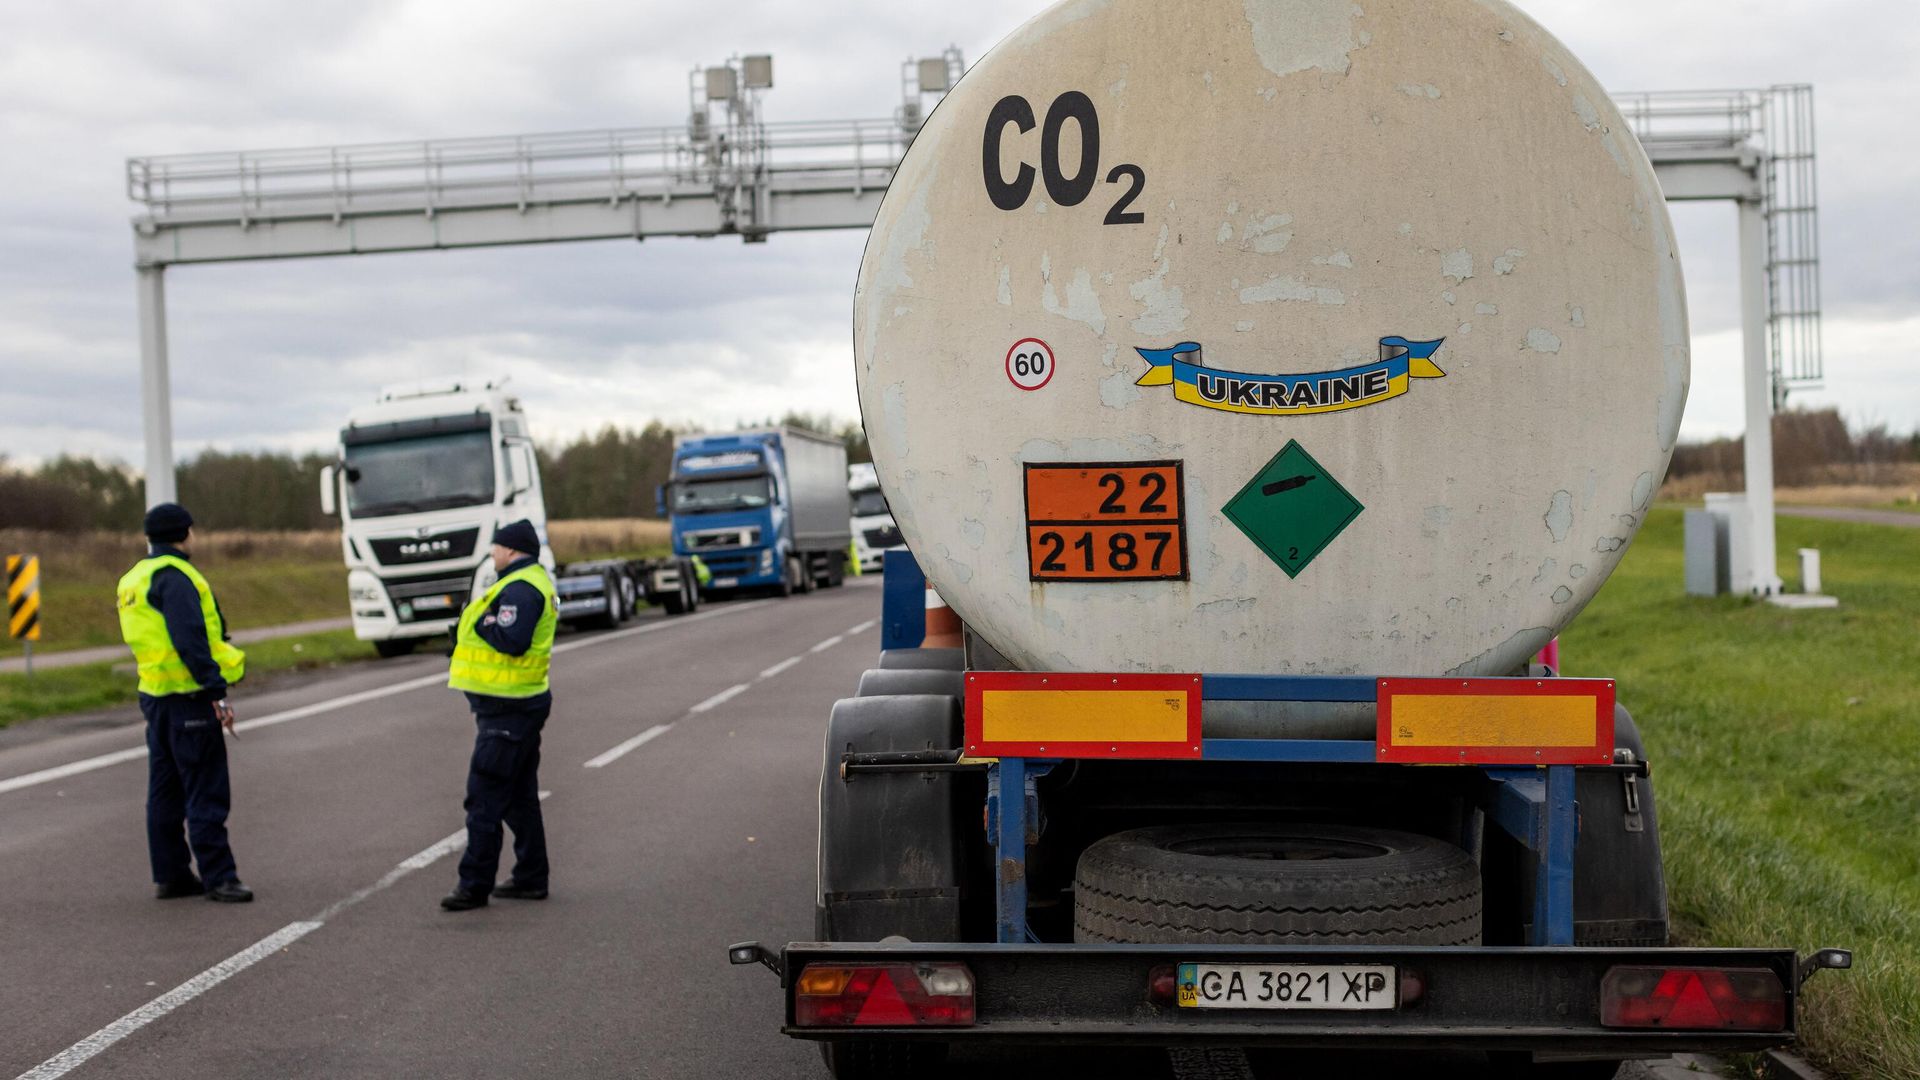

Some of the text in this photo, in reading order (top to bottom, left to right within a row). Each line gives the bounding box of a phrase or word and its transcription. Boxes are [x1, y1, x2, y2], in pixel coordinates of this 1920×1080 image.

[1015, 351, 1045, 376] 60
[1197, 369, 1389, 409] UKRAINE
[1098, 473, 1168, 513] 22
[1039, 532, 1172, 571] 2187
[1288, 547, 1298, 560] 2
[1181, 991, 1196, 1001] UA
[1201, 971, 1386, 1001] CA 3821 XP
